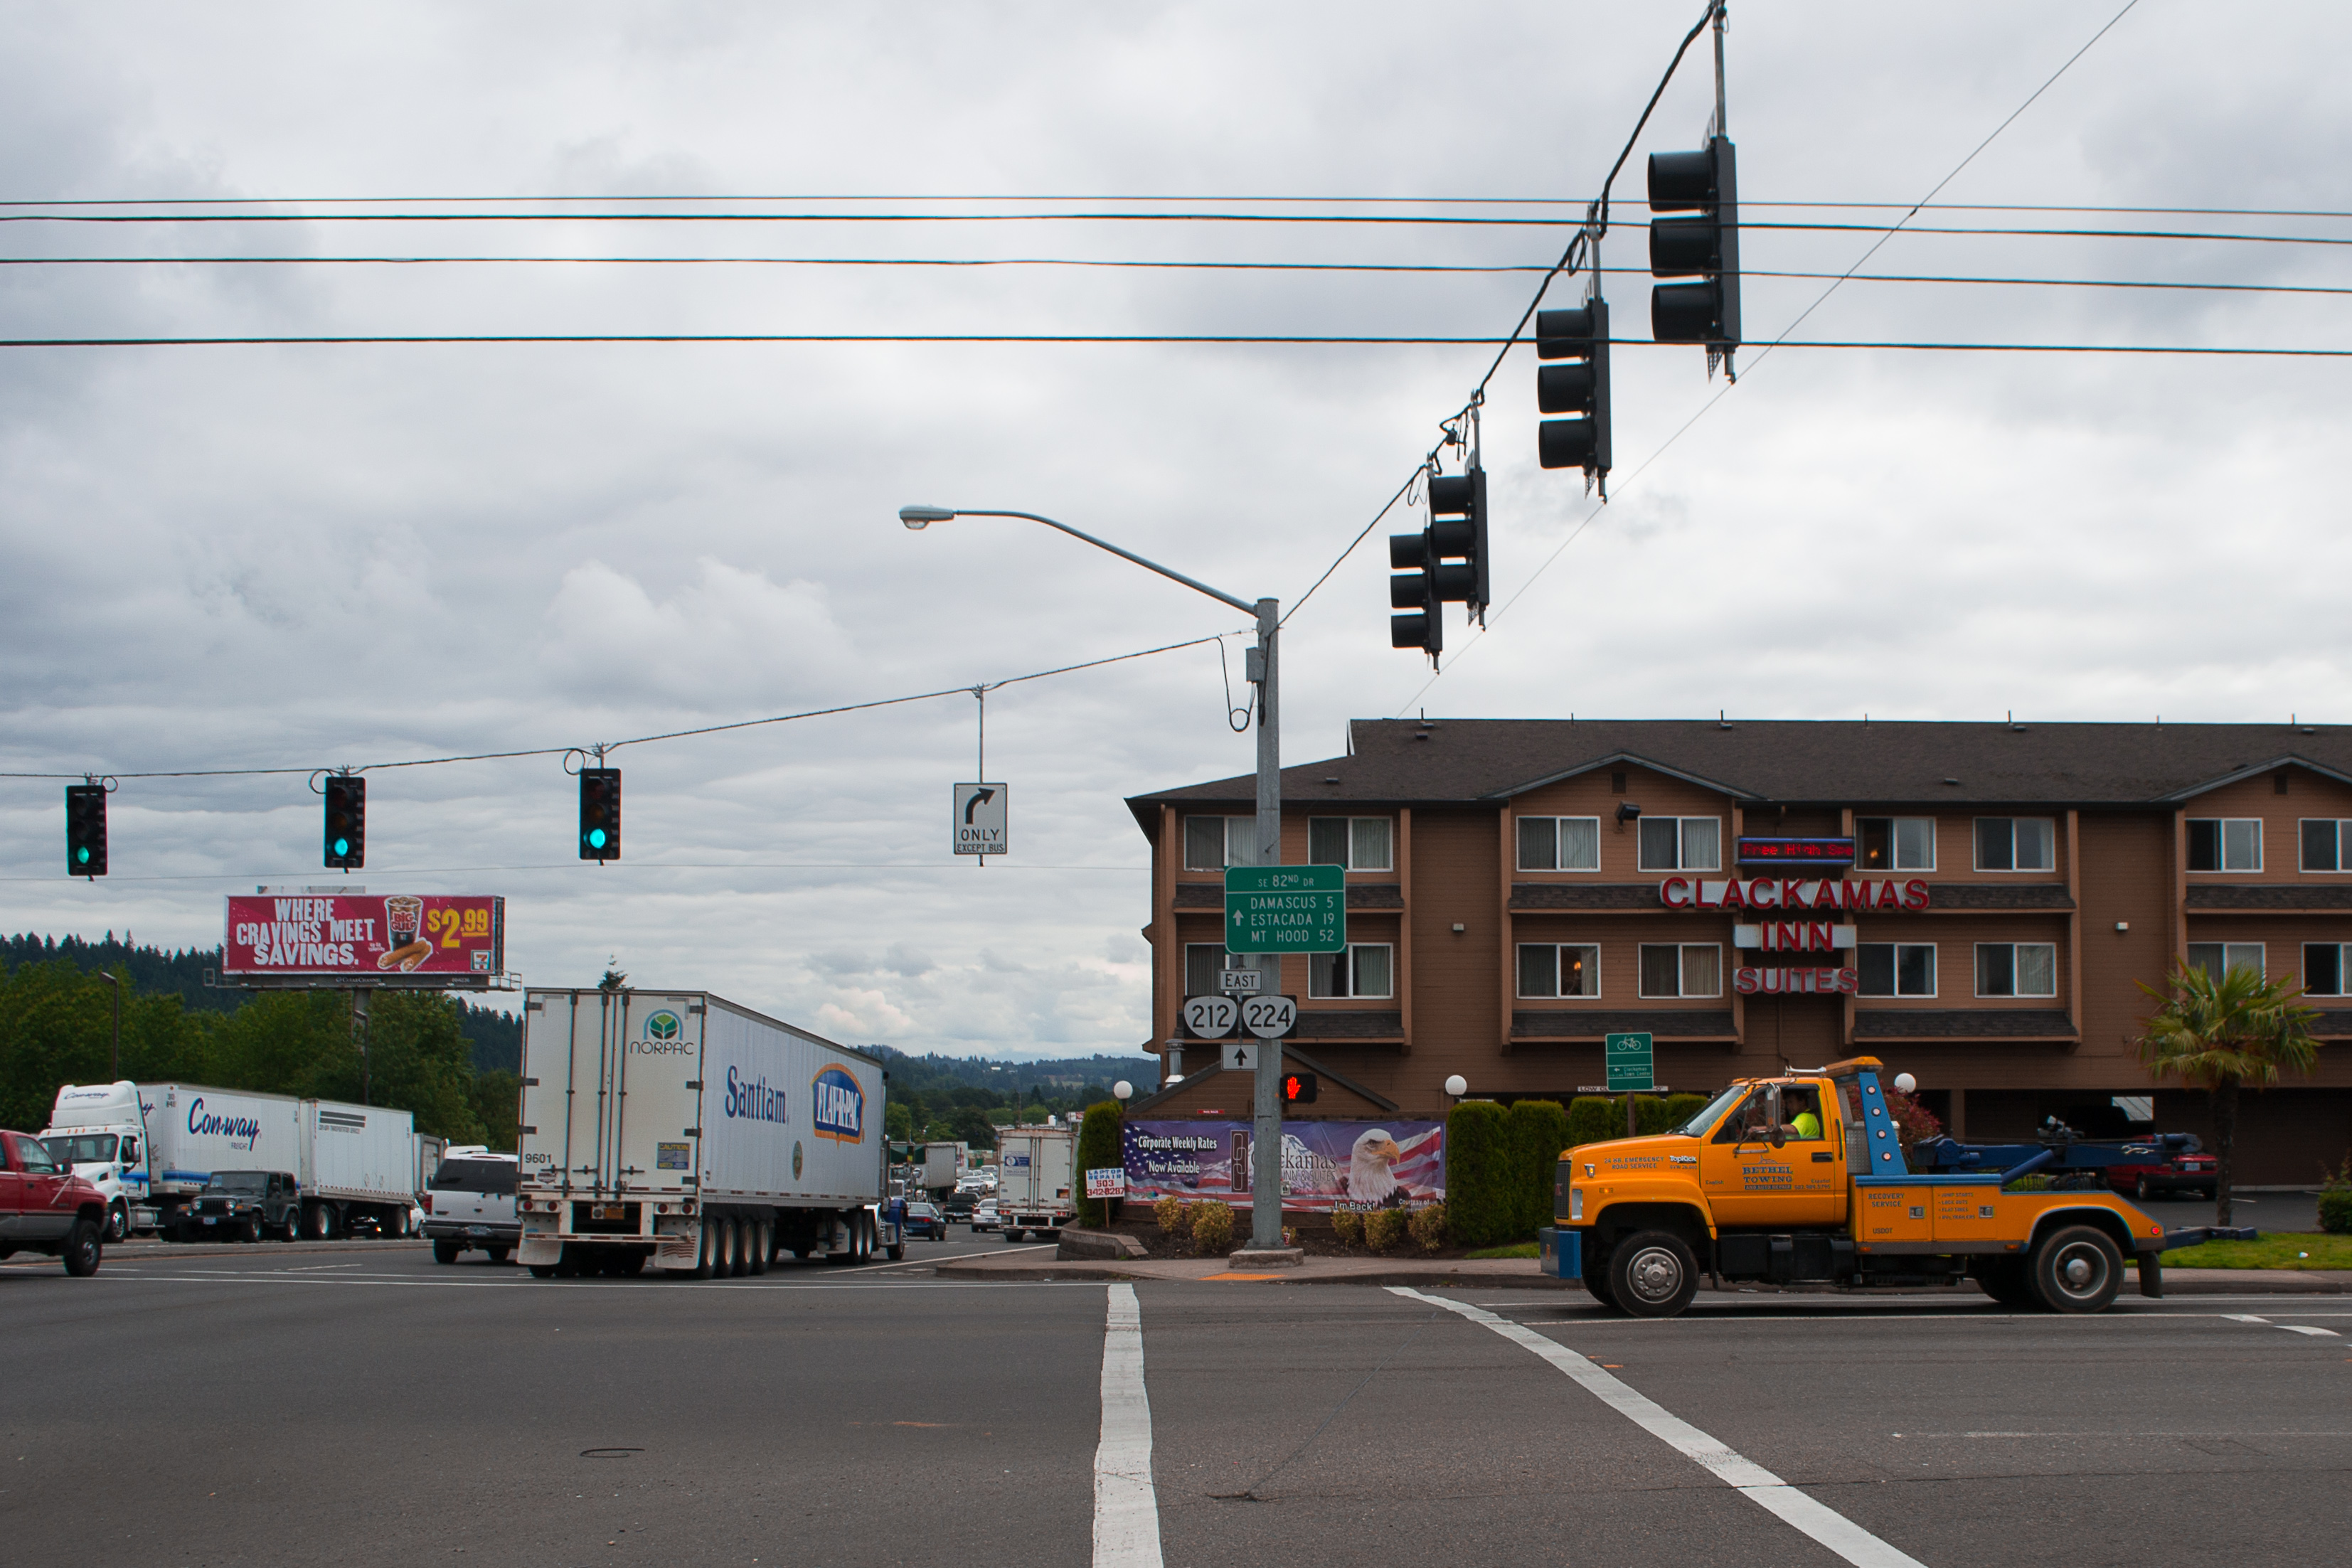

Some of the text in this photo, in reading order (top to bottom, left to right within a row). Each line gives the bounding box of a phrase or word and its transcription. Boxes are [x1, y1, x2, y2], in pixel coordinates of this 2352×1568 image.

[961, 828, 999, 841] ONLY
[957, 843, 1004, 852] EXCEPT BUS
[1743, 843, 1778, 855] Free
[1257, 875, 1314, 887] SE 82ND DR
[1661, 876, 1930, 910] CLACKAMAS
[1250, 896, 1334, 910] DAMASCUS 5
[275, 899, 334, 922] WHERE
[1250, 913, 1334, 926] ESTACADA 19
[237, 919, 375, 945] CRAVINGS MEET
[427, 908, 489, 948] $2.99
[1251, 929, 1334, 942] MT HOOD 52
[1761, 921, 1834, 951] INN
[254, 944, 359, 965] SAVINGS.
[1225, 974, 1256, 988] EAST
[1736, 966, 1858, 994] SUITES
[1191, 1004, 1230, 1028] 212
[1249, 1004, 1291, 1028] 224
[630, 1041, 694, 1055] NORPAC
[725, 1065, 787, 1125] Santiam
[1138, 1136, 1217, 1151] Corporate Weekly Rates
[525, 1153, 552, 1163] 9601
[1149, 1161, 1200, 1173] Now Available
[1742, 1166, 1793, 1175] BETHEL
[1283, 1170, 1336, 1182] INN & SUITES
[1398, 1198, 1422, 1207] Courtesy
